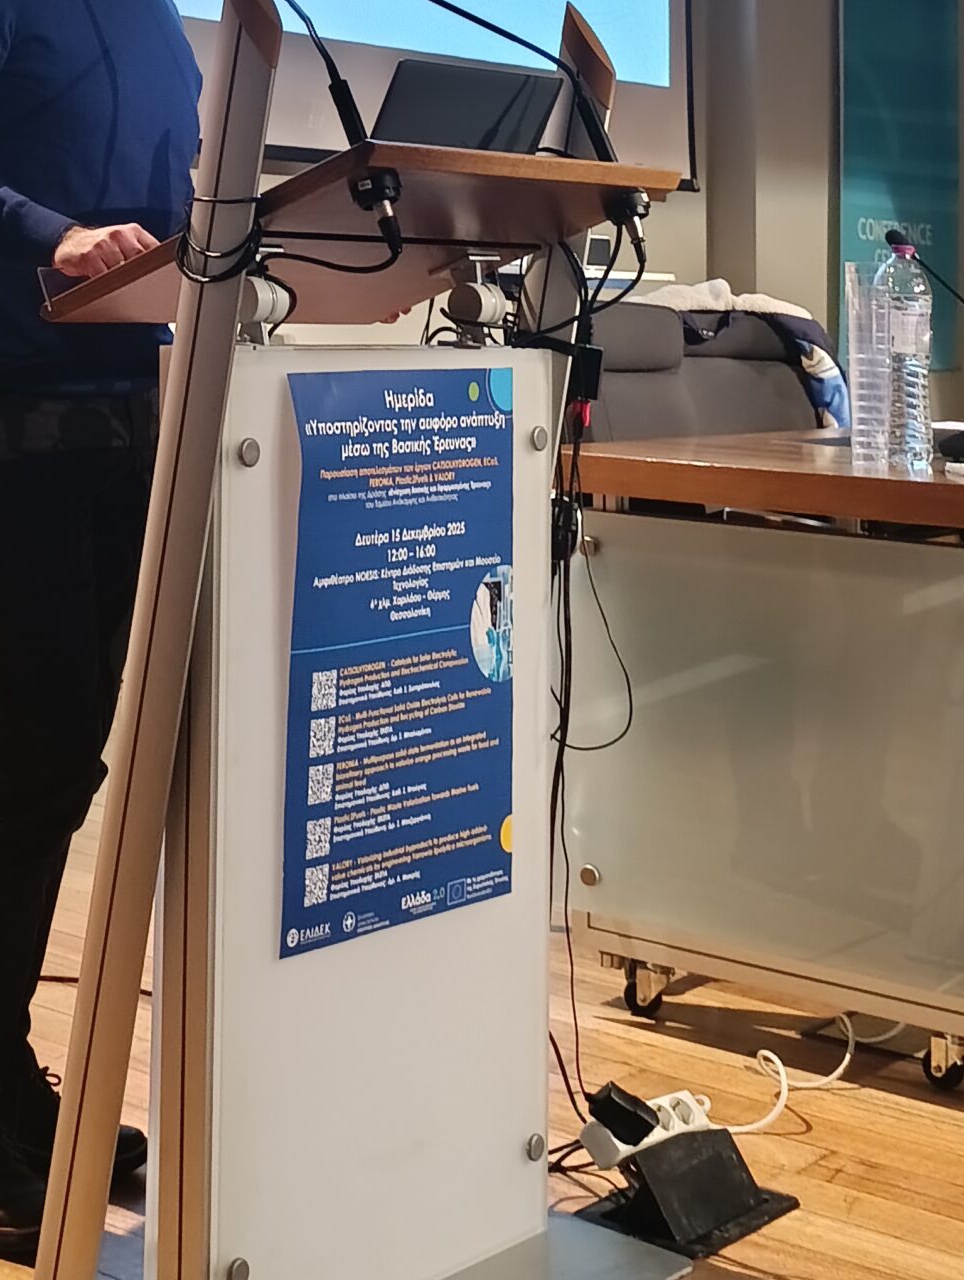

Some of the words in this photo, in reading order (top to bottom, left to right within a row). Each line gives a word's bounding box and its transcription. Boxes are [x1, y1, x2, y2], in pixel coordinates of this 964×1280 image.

[384, 387, 434, 412] Ημερίδα
[305, 416, 398, 437] «Υποστηρίζοντας
[400, 418, 416, 434] την
[419, 414, 458, 434] αειφόρο
[460, 410, 506, 429] ανάπτυξη
[341, 440, 370, 460] μέσω
[373, 442, 389, 459] της
[392, 434, 431, 455] Βασικής
[433, 434, 476, 455] Έρευνας»
[355, 530, 389, 547] Δευτέρα
[391, 529, 401, 542] 15
[402, 525, 445, 541] Δεκεμβρίου
[447, 521, 466, 535] 2025
[387, 548, 408, 562] 12:00
[416, 544, 436, 558] 16:00
[401, 891, 432, 910] Ελλάδα
[300, 923, 331, 942] ΕΛΙΔΕΚ
